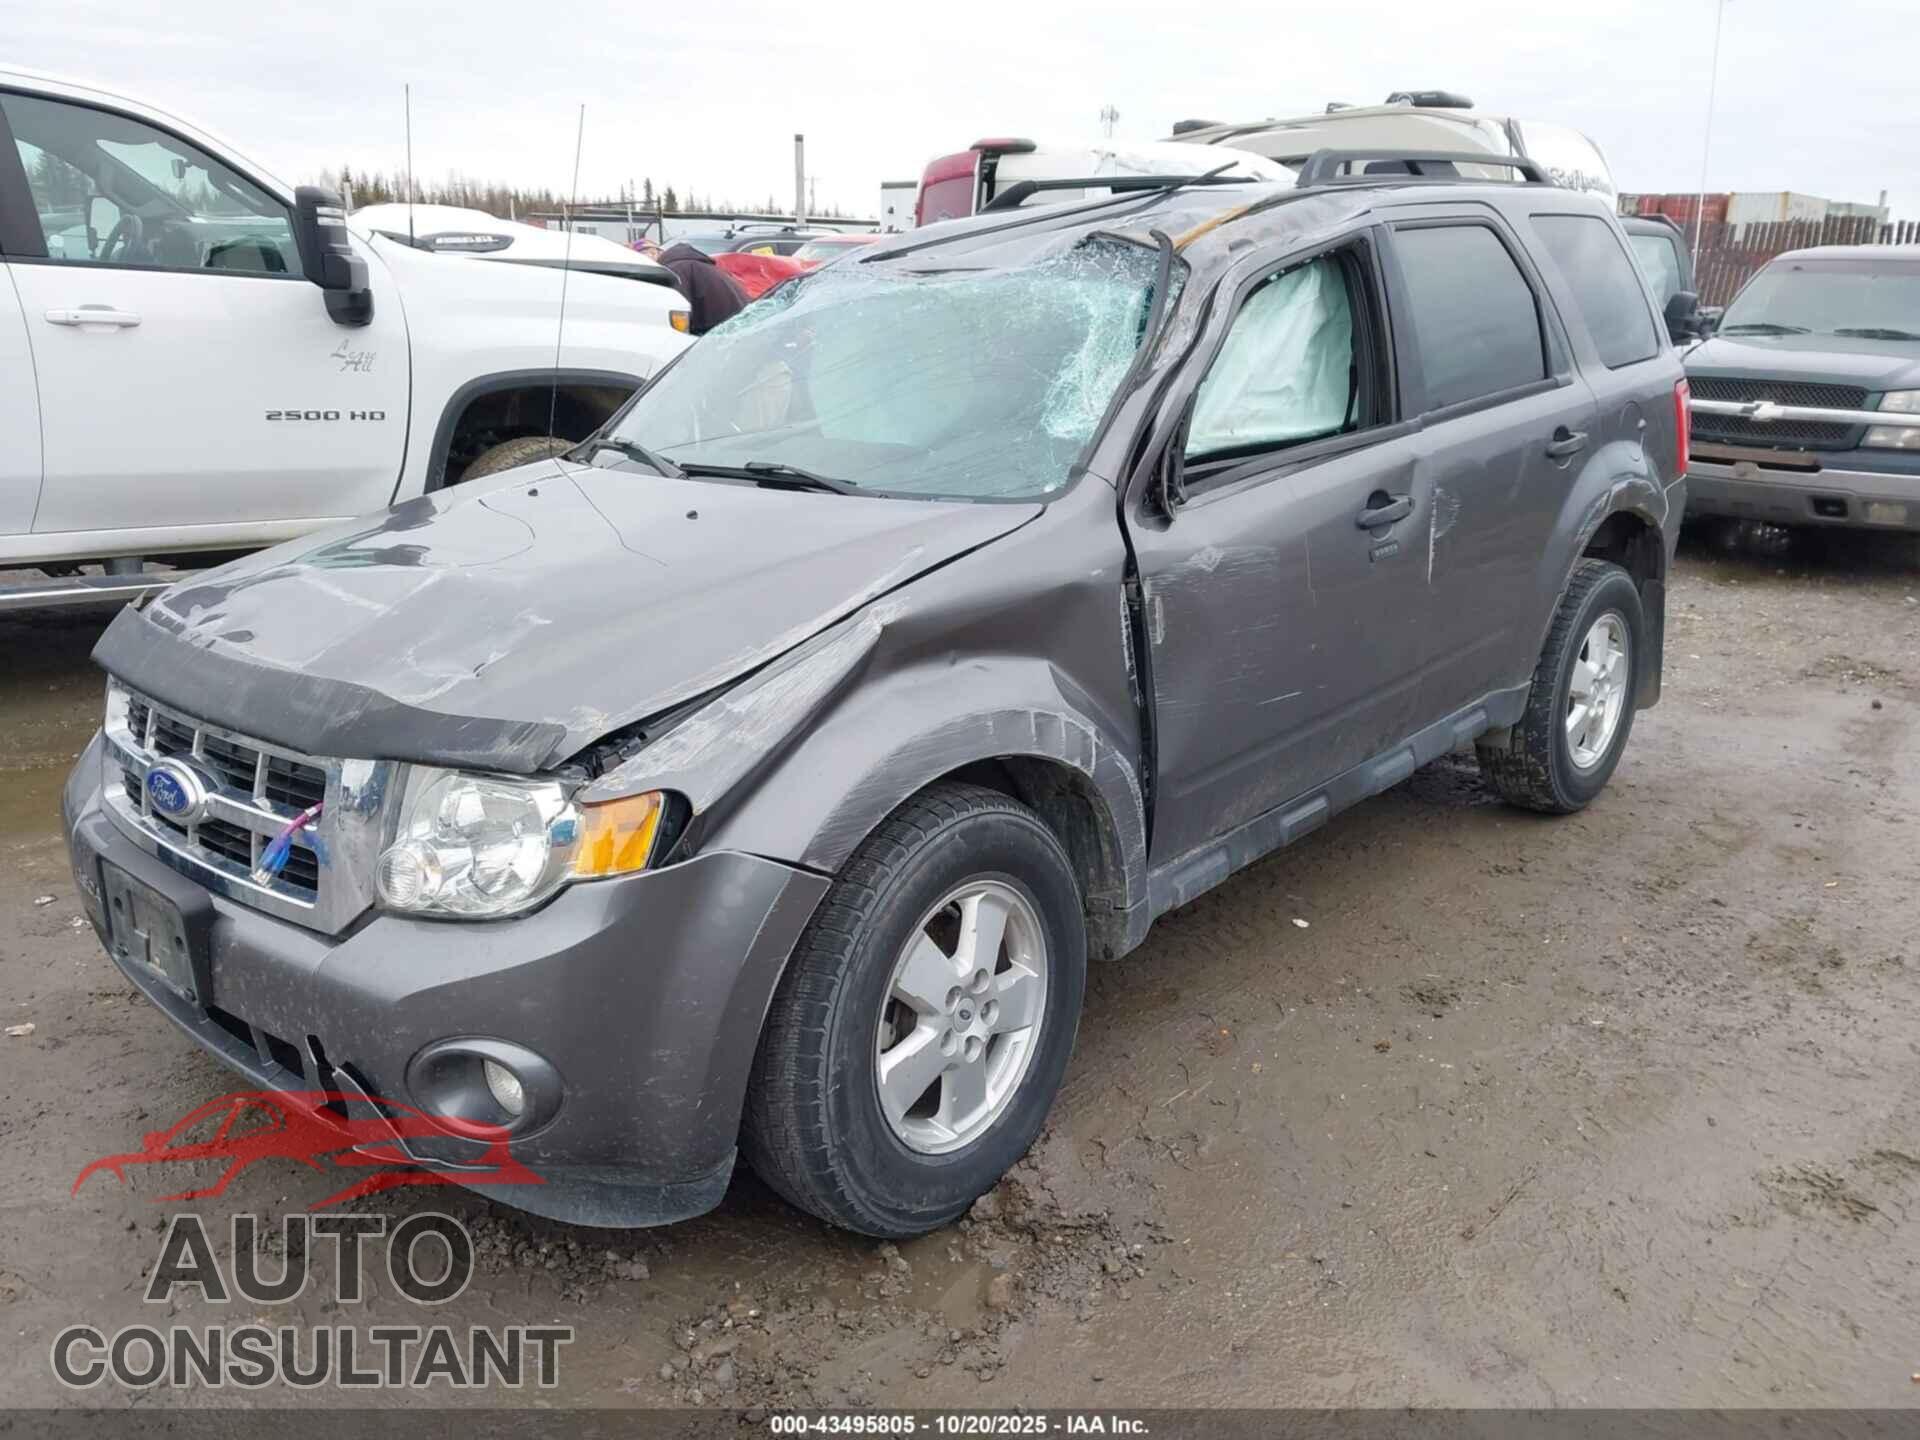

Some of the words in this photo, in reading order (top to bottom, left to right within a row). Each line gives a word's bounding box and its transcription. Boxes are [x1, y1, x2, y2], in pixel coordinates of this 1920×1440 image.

[265, 409, 340, 421] 2500
[350, 410, 386, 421] HD
[151, 774, 179, 807] Ford
